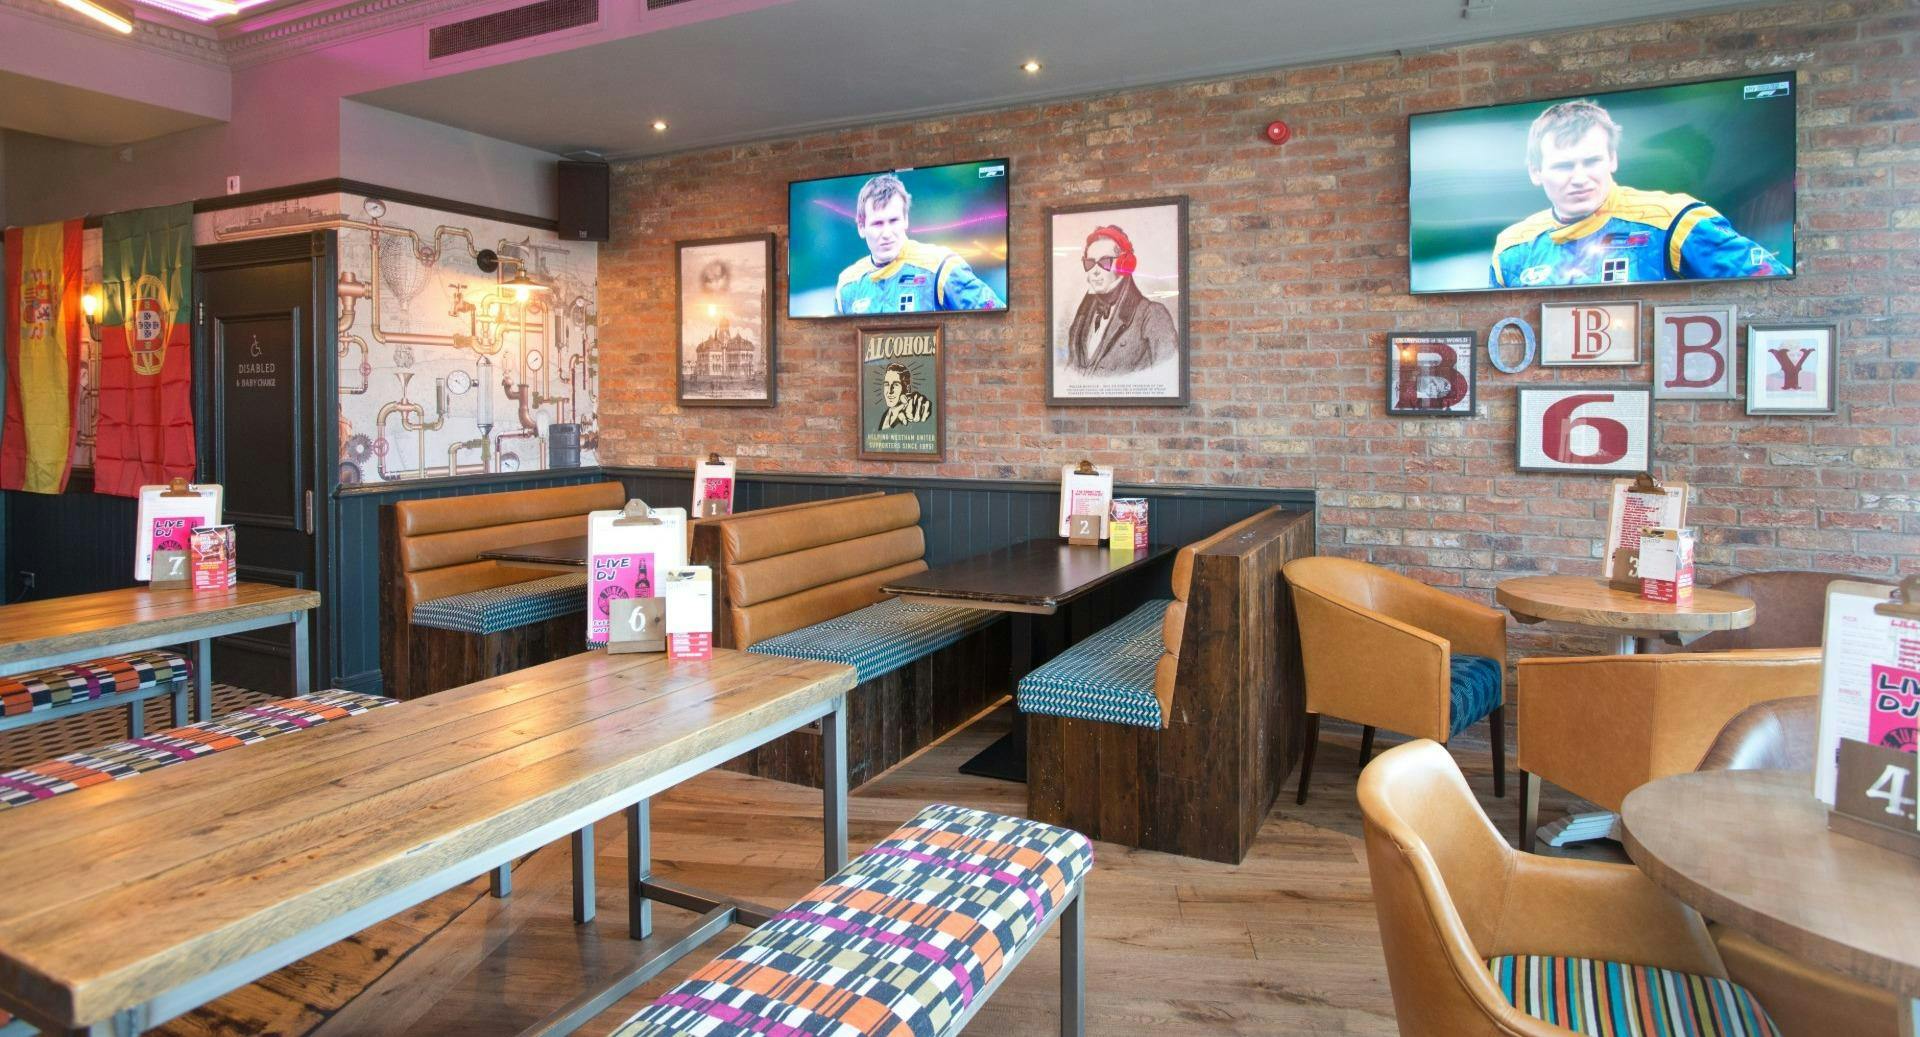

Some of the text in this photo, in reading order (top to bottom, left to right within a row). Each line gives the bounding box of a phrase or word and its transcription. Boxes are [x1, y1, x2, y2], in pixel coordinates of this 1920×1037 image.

[864, 335, 937, 362] ALCOHOL!
[1394, 308, 1816, 408] B O B B Y
[239, 363, 276, 374] DISABLED
[1542, 394, 1628, 465] 6
[917, 434, 934, 442] UNITED
[711, 503, 717, 515] 1
[155, 520, 184, 529] LIVE
[1079, 520, 1090, 535] 2
[155, 529, 172, 537] DJ
[596, 558, 630, 569] LIVE
[1629, 556, 1638, 577] 3
[596, 571, 616, 581] DJ
[1878, 673, 1920, 696] LIV
[1878, 694, 1920, 717] DJ
